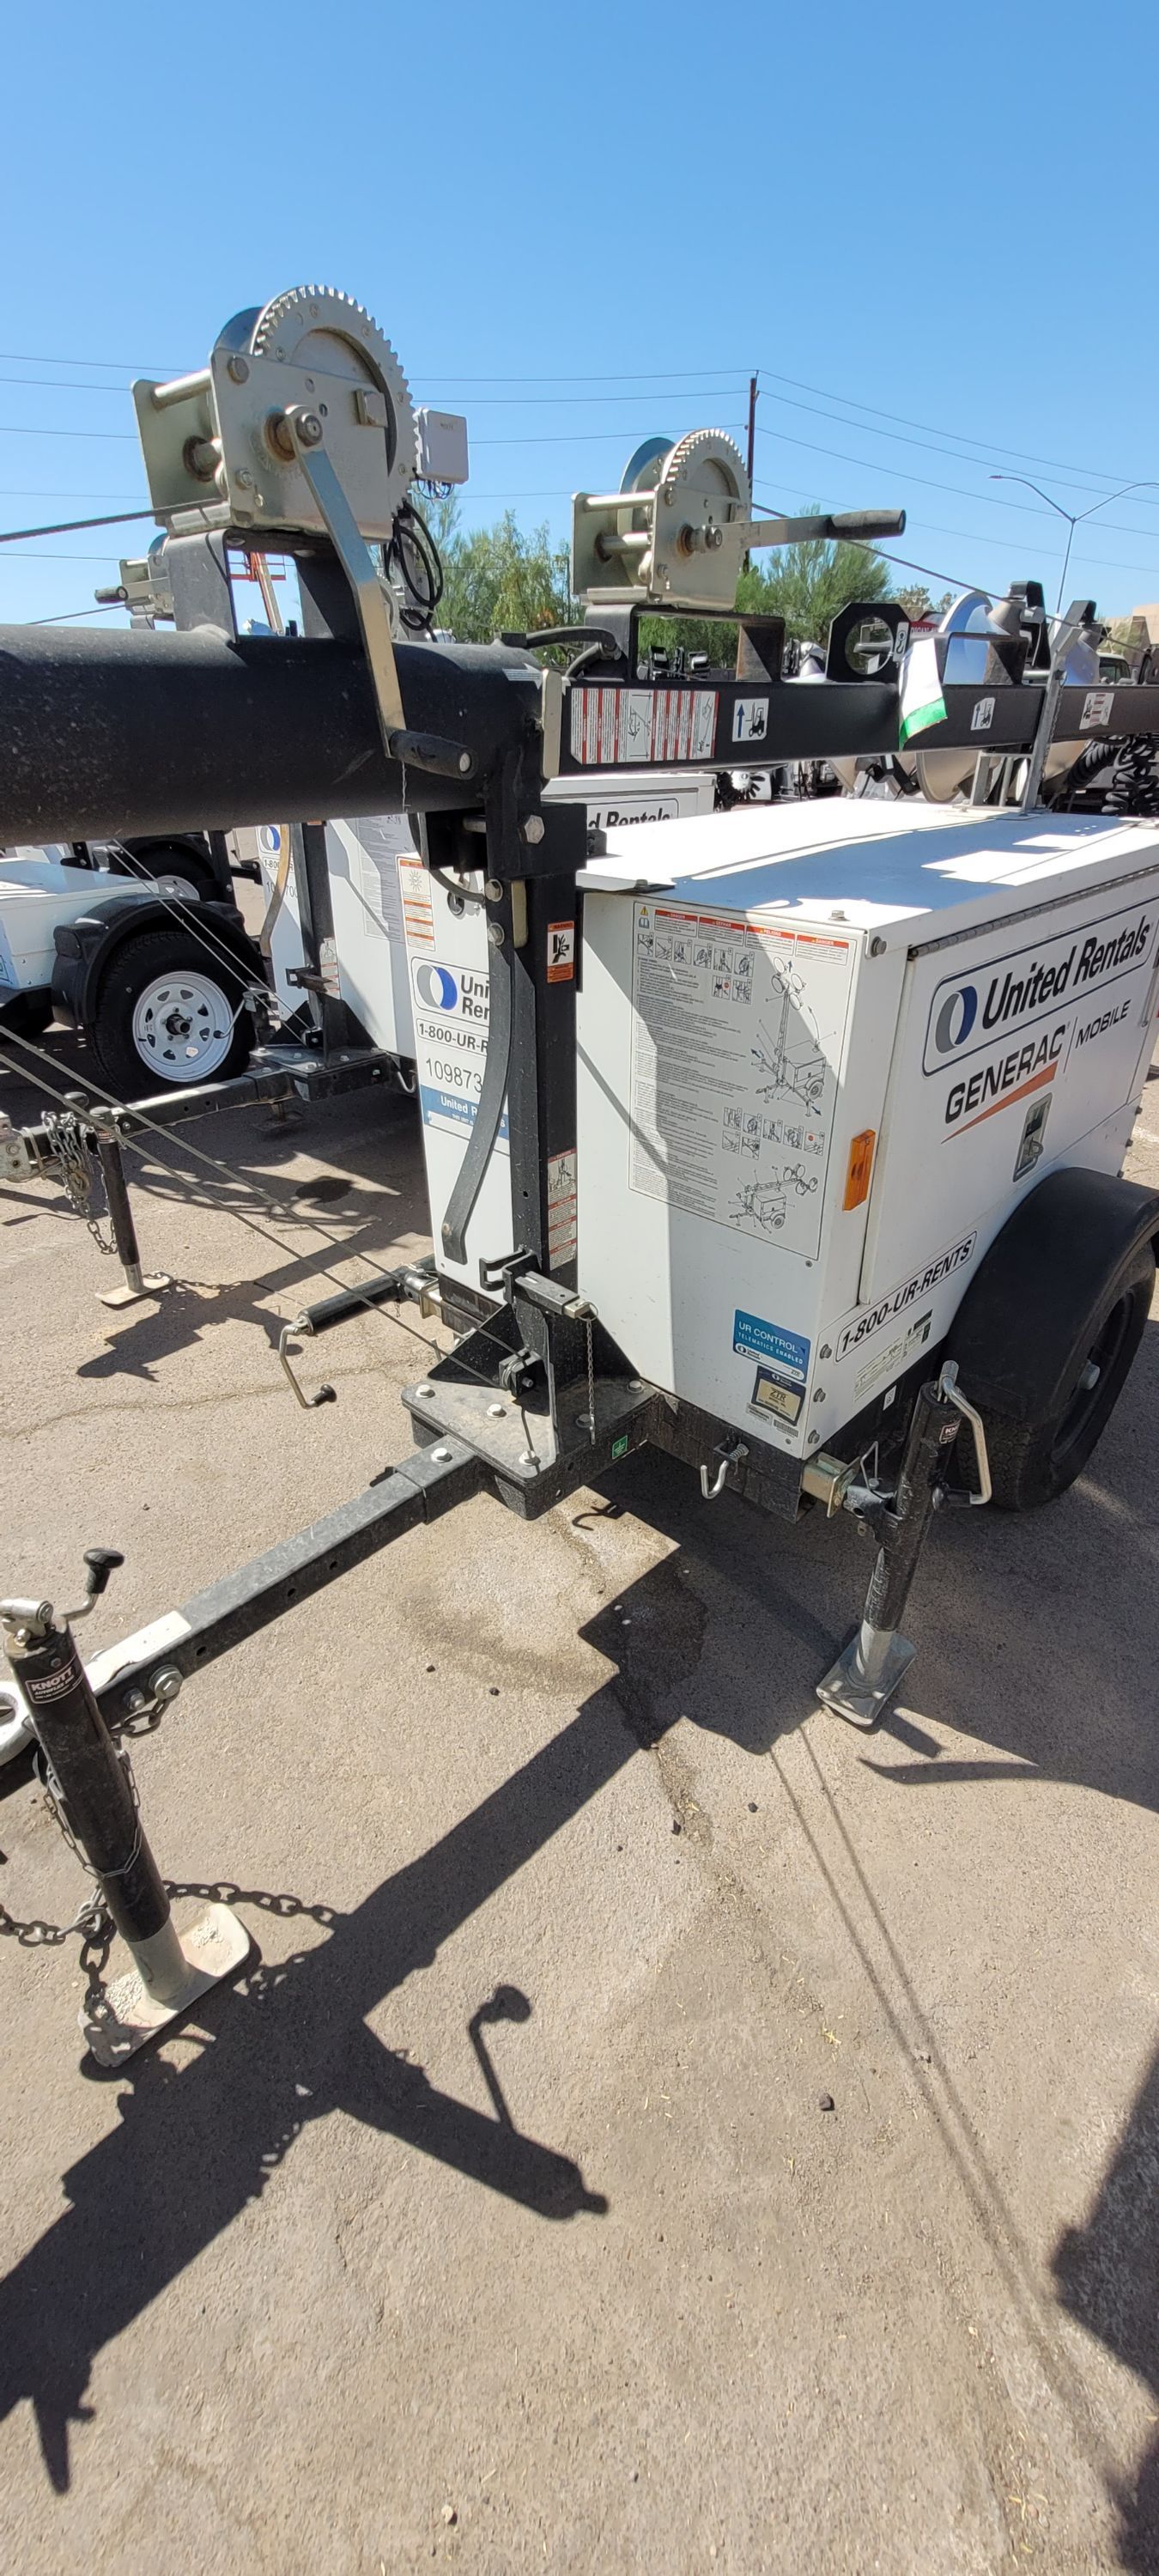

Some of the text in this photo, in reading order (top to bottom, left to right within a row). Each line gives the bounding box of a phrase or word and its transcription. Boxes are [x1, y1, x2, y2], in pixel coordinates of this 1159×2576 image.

[982, 915, 1150, 1030] United Rentals
[419, 1023, 488, 1053] 1-800-UR-R
[945, 999, 1132, 1124] GENERAC MOBILE
[440, 1095, 469, 1114] United
[840, 1237, 973, 1353] 1-800-UR-RENTS
[737, 1332, 774, 1352] TELEMATICS
[775, 1349, 804, 1365] ENABLED
[738, 1321, 798, 1354] UR CONTROL
[31, 1666, 73, 1692] KNOTT
